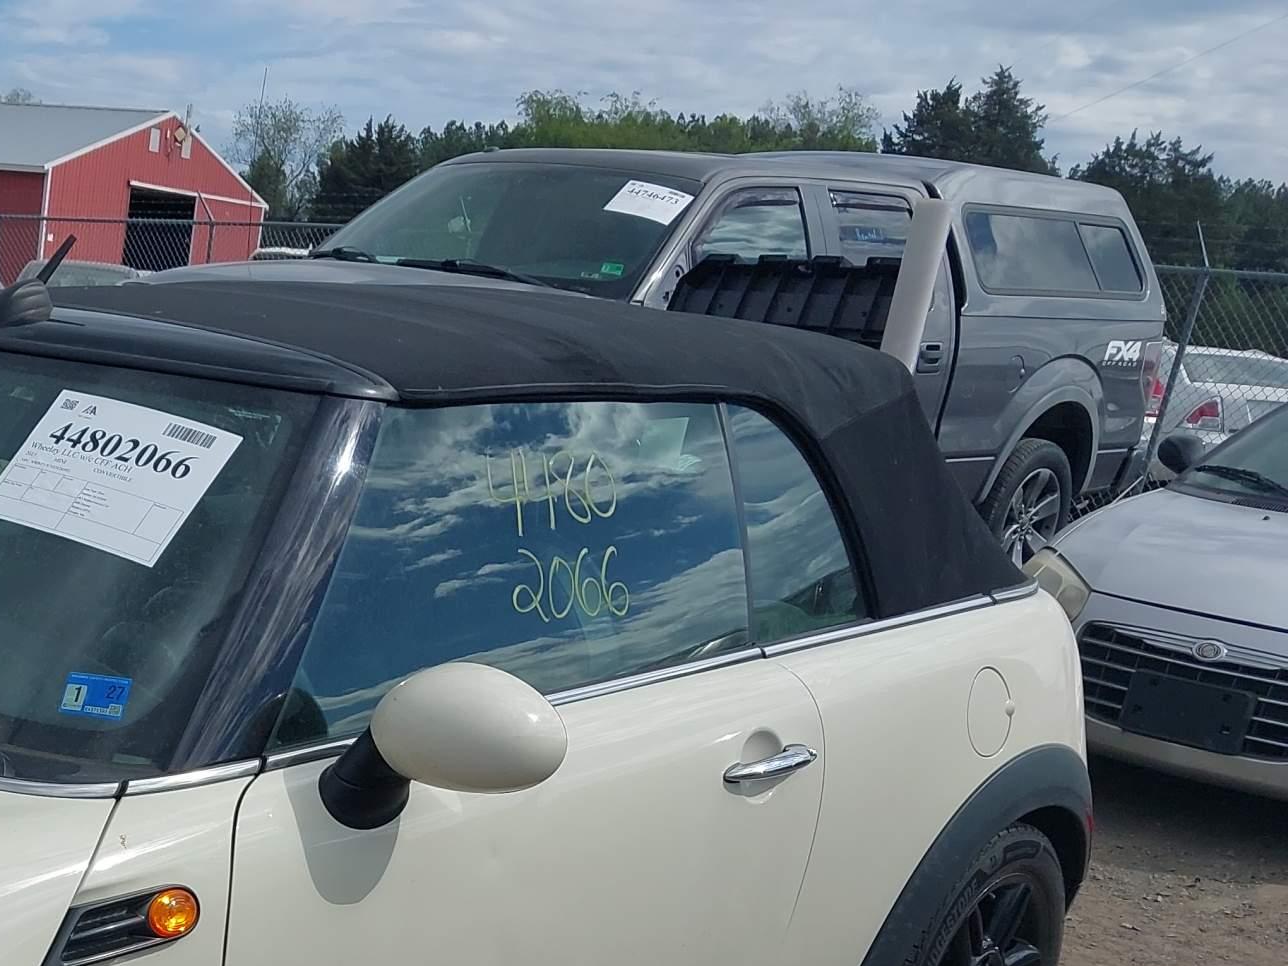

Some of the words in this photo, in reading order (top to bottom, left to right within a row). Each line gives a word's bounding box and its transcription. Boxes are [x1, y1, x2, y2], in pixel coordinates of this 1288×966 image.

[1103, 341, 1142, 361] FX4
[49, 422, 200, 480] 44802066
[61, 449, 80, 459] LLC
[111, 463, 133, 474] ACH
[513, 546, 629, 622] 2066
[74, 686, 82, 703] 1
